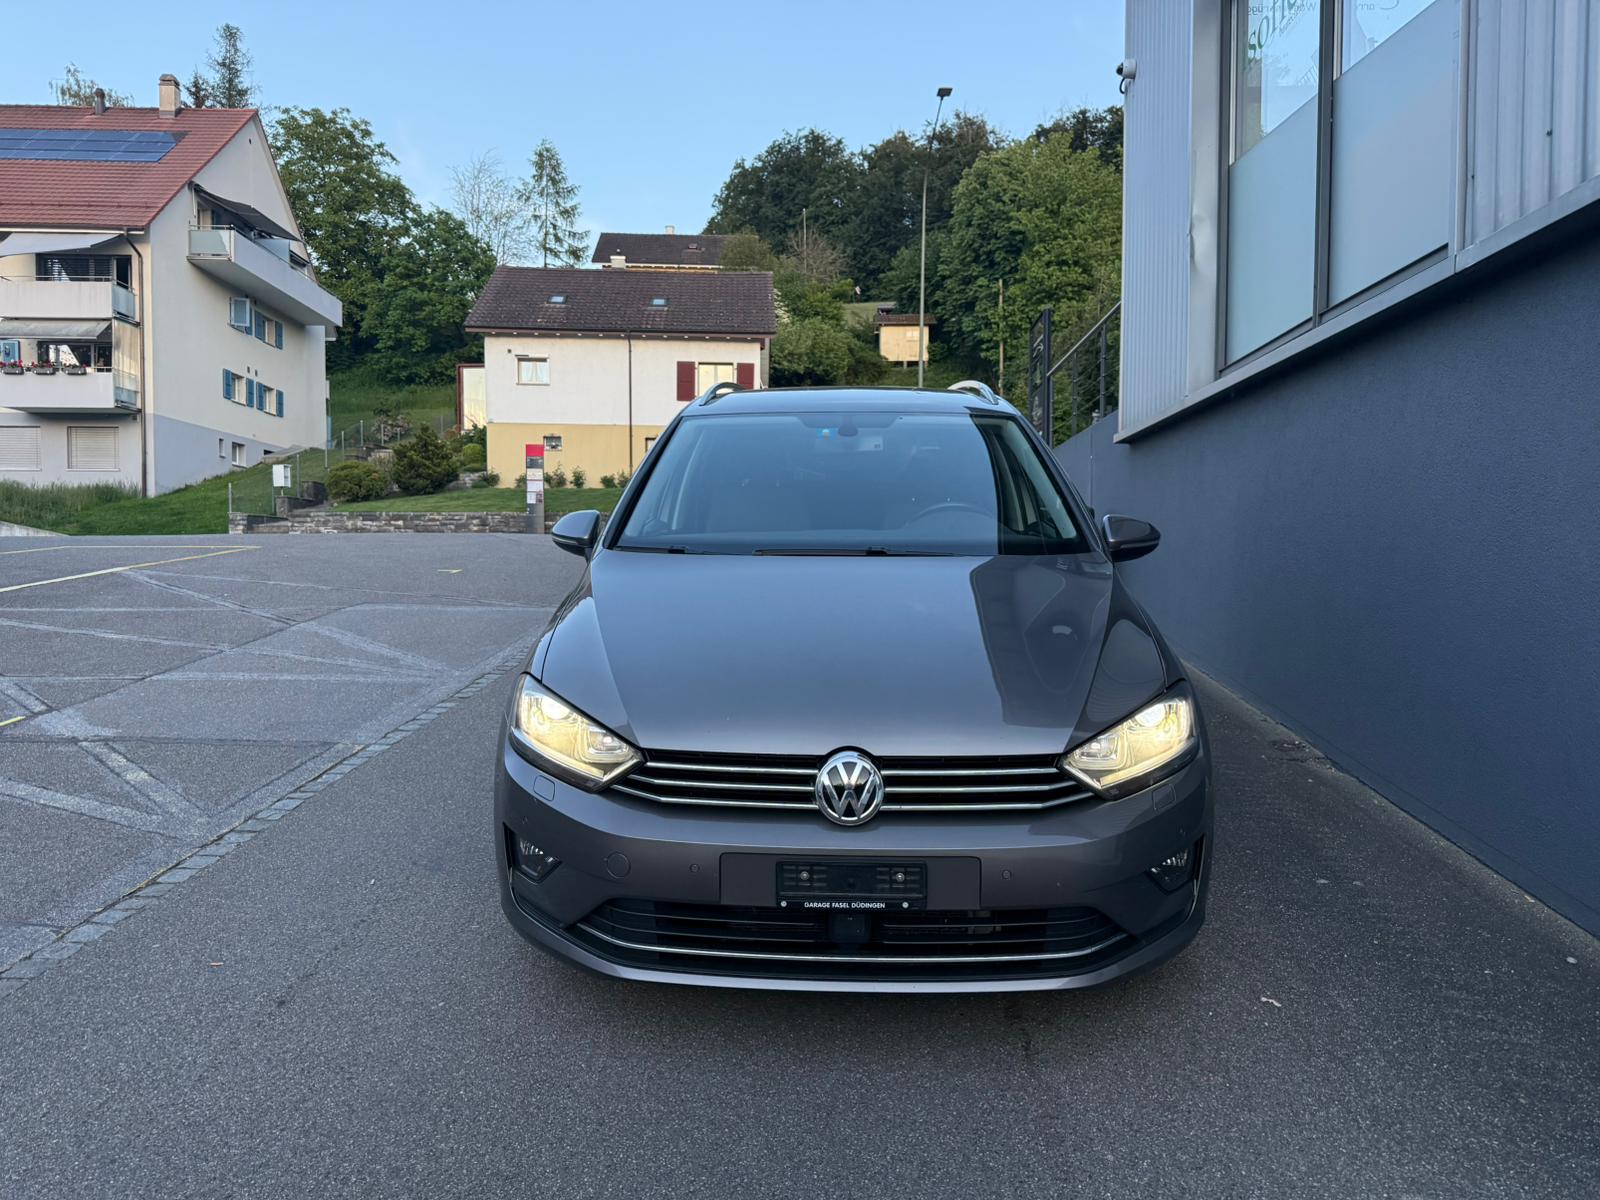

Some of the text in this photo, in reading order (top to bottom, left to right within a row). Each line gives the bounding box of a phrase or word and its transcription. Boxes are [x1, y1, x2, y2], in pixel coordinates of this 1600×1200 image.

[804, 901, 886, 909] GARAGE FASEL DÜDINGEN
